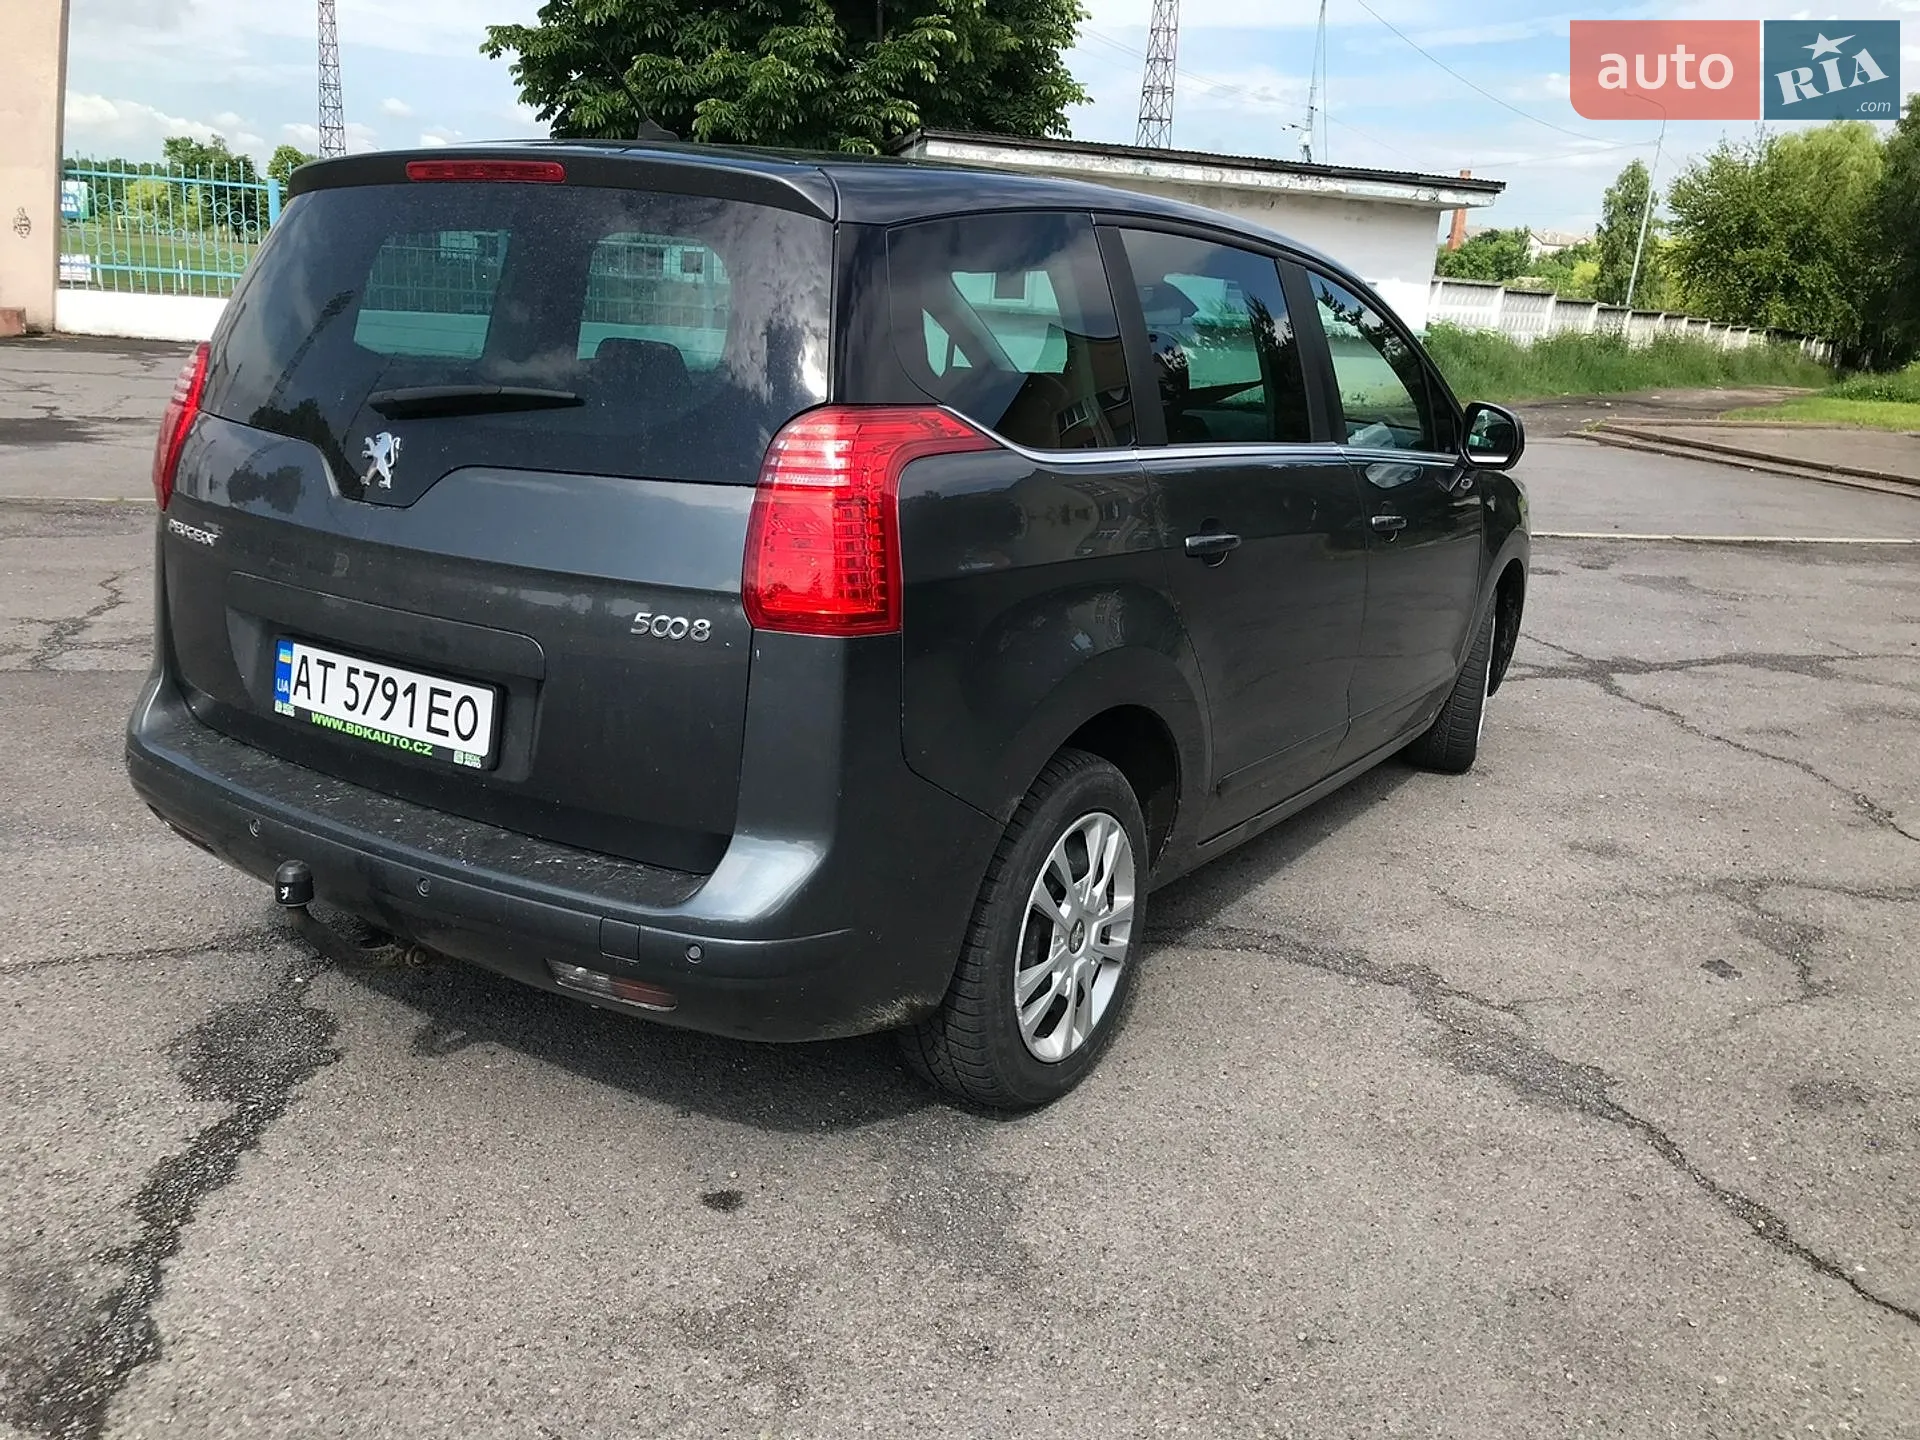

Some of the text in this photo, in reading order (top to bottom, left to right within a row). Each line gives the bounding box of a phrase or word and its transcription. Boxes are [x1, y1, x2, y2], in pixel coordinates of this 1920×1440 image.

[630, 611, 711, 643] 5008
[276, 678, 290, 694] UA
[292, 654, 479, 742] AT 5791 EO
[309, 711, 434, 757] WWW.BDKAUTO.CZ
